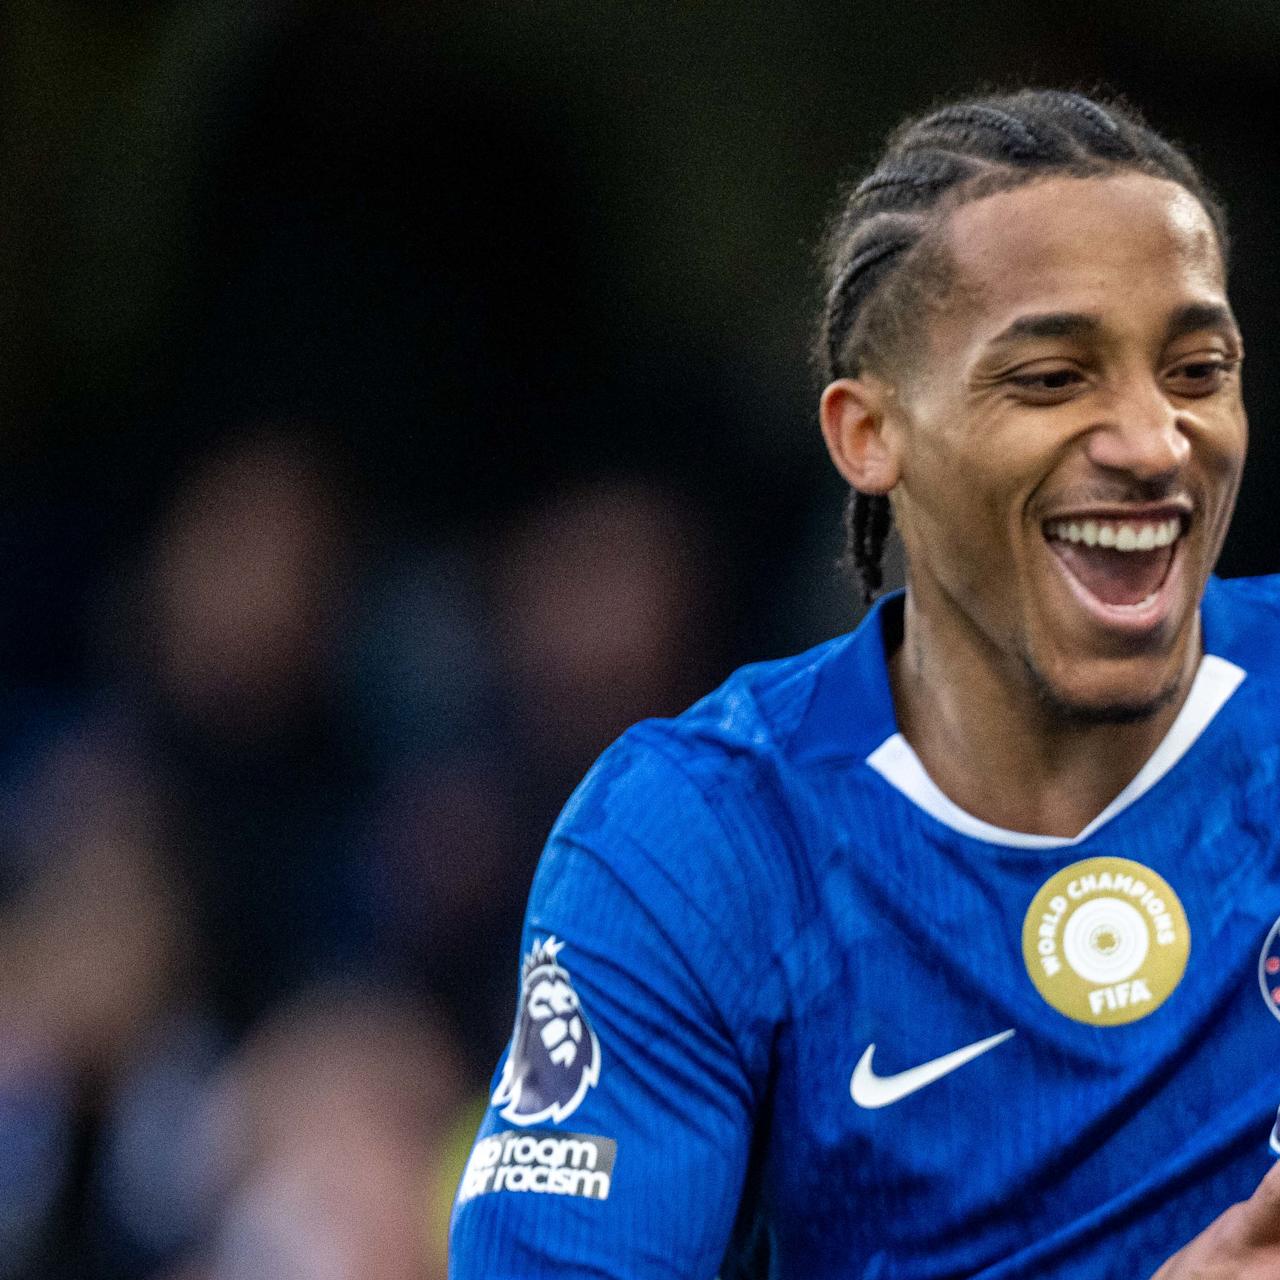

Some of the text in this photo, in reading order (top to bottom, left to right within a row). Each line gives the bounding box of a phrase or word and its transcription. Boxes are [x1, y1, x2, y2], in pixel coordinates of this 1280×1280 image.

[1038, 871, 1175, 977] WORLD CHAMPIONS
[1088, 978, 1153, 1015] FIFA
[502, 1135, 598, 1169] room
[493, 1164, 611, 1200] racism
